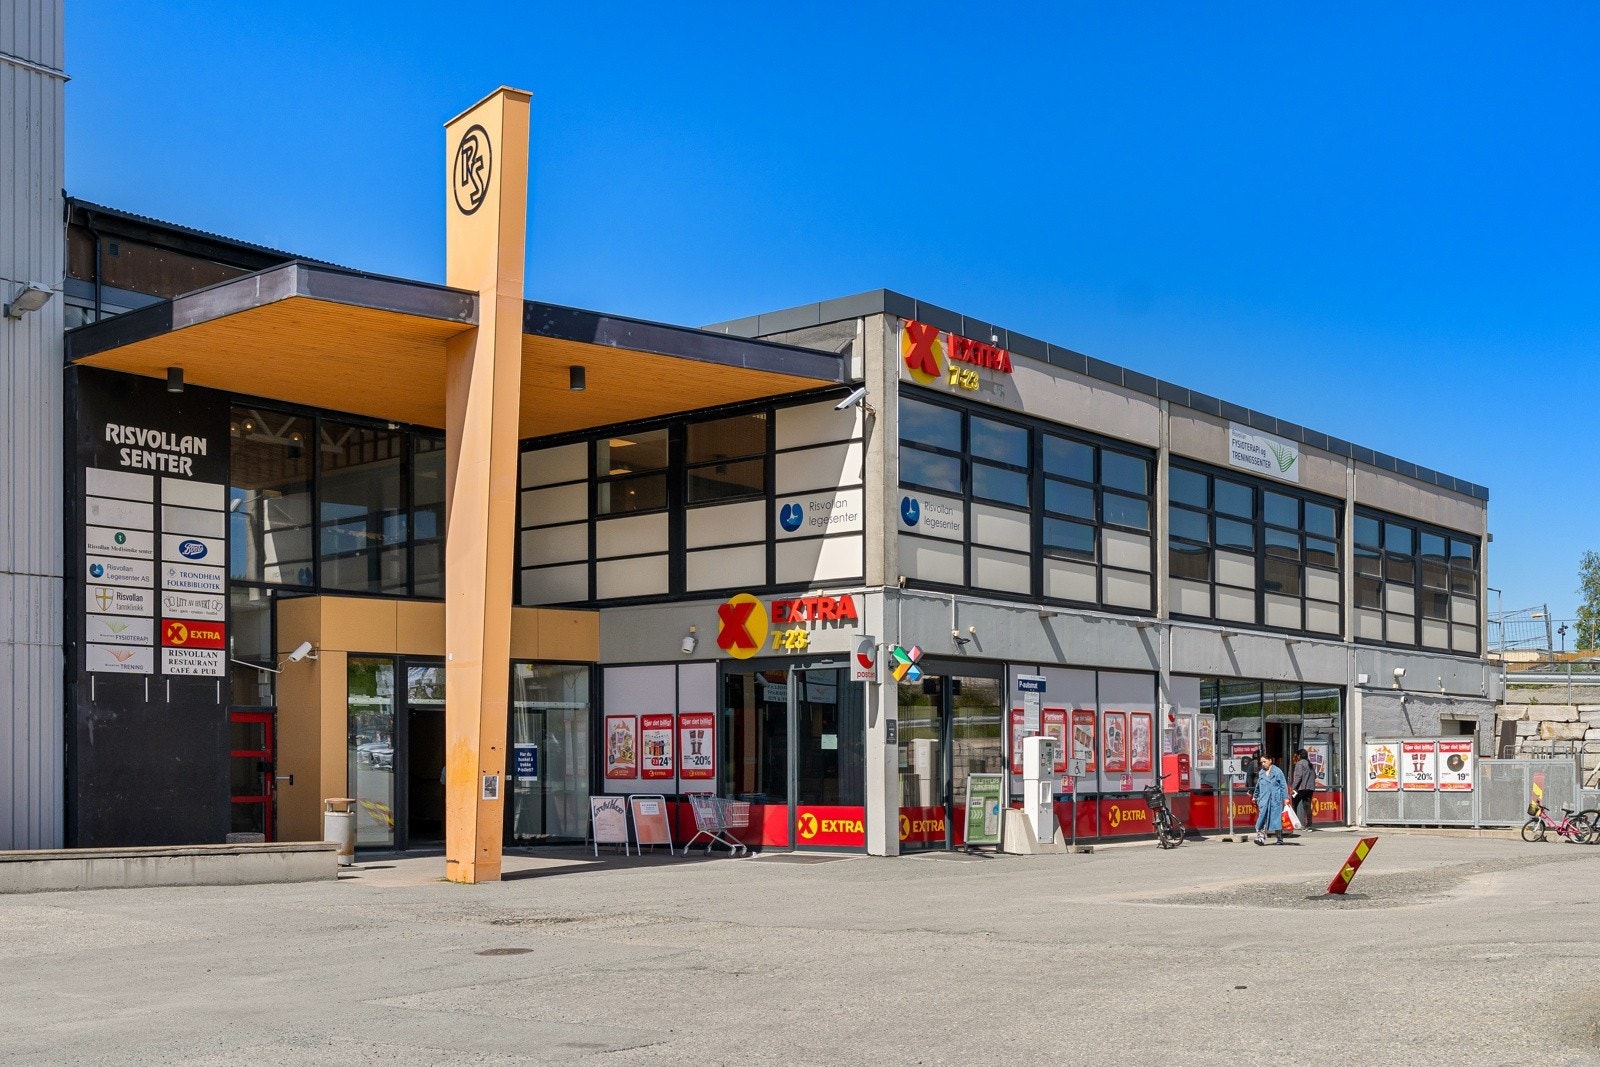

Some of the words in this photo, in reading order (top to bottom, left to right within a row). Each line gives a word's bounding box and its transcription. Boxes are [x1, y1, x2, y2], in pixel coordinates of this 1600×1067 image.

[948, 333, 1014, 374] EXTRA
[948, 365, 980, 391] 7-23
[106, 423, 207, 456] RISVOLLAN
[1232, 438, 1261, 454] FYSIOTERAPI
[120, 448, 194, 477] SENTER
[1232, 450, 1272, 469] TRENINGSSENTER
[810, 499, 848, 512] Risvollan
[924, 501, 954, 516] Risvollan
[809, 512, 858, 527] legesenter
[924, 516, 961, 532] legesenter
[107, 564, 133, 572] Risvollan
[107, 574, 140, 582] Legesenter
[180, 572, 220, 581] TRONDHEIM
[167, 580, 220, 590] FOLKEBIBLIOTEK
[116, 592, 144, 602] Risvollan
[772, 594, 858, 624] EXTRA
[190, 630, 220, 640] EXTRA
[168, 650, 218, 658] RISVOLLAN
[168, 658, 218, 667] RESTAURANT
[660, 757, 668, 766] 24
[693, 756, 711, 766] -20%
[1238, 804, 1257, 815] EXTRA
[1320, 802, 1337, 811] EXTRA
[1122, 810, 1146, 821] EXTRA
[822, 820, 864, 834] EXTRA
[912, 820, 945, 834] EXTRA
